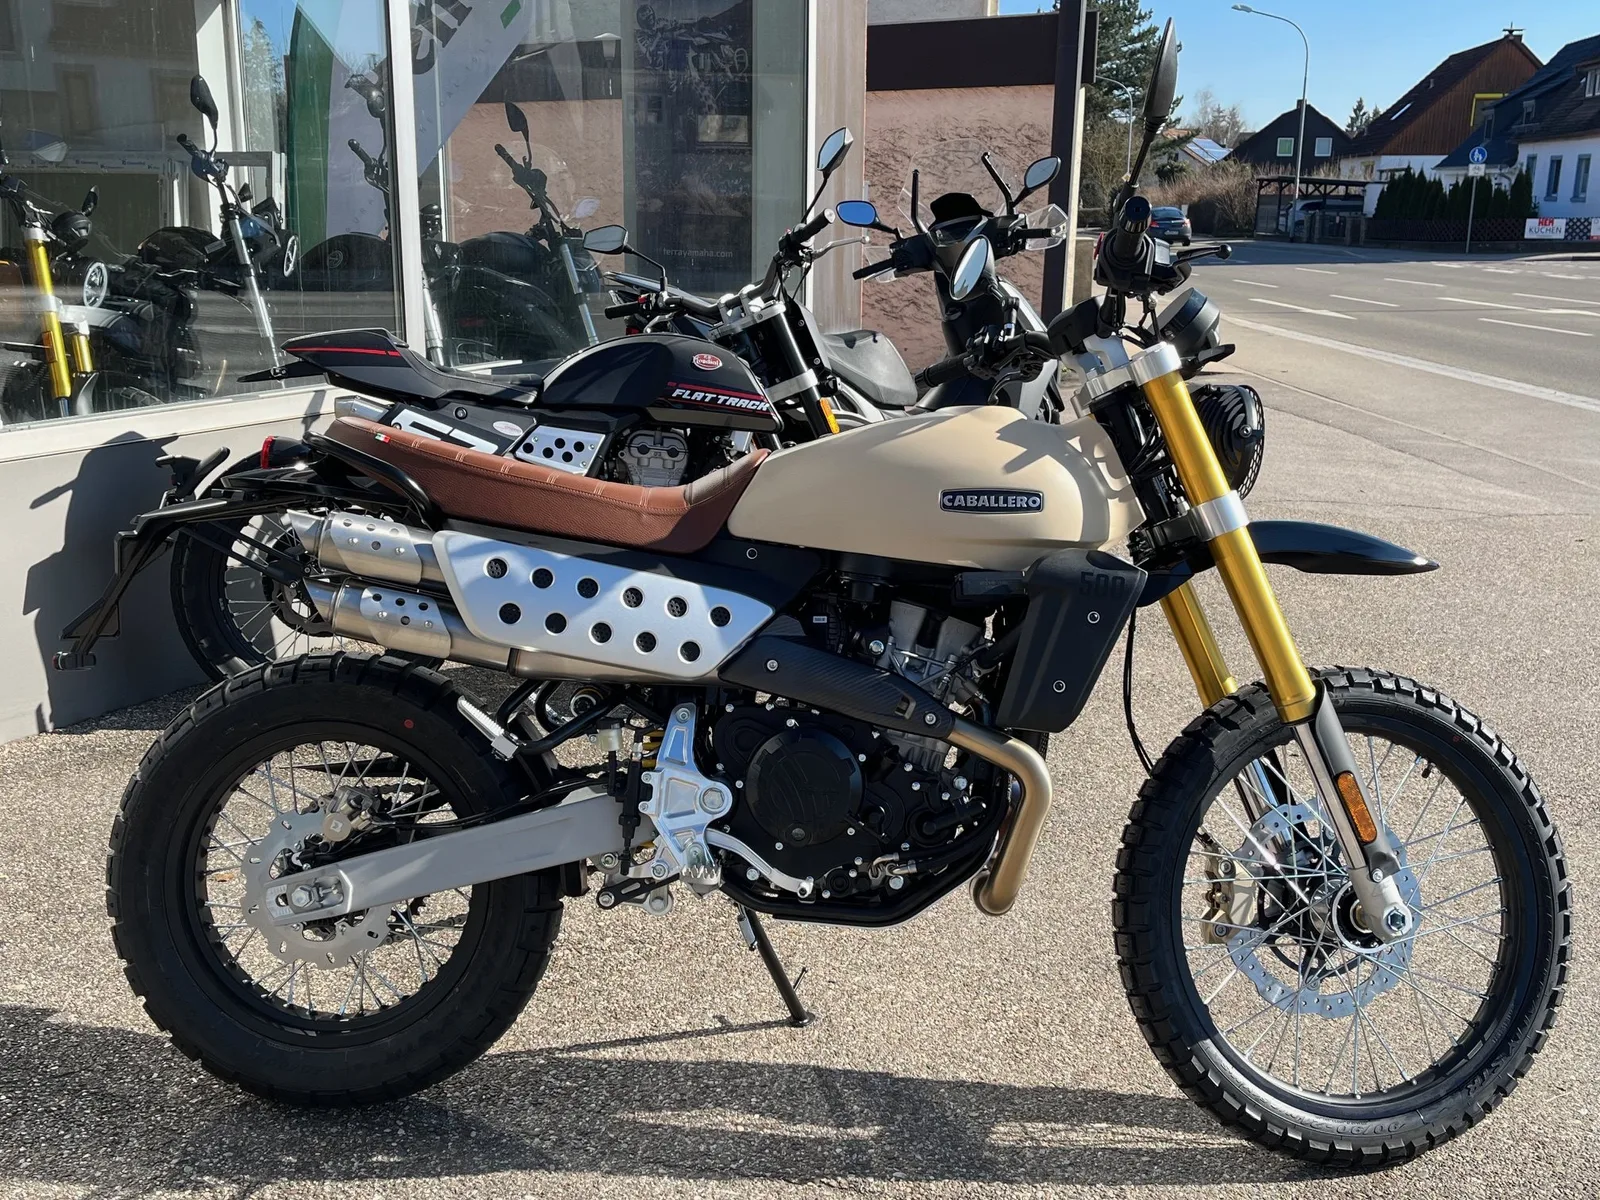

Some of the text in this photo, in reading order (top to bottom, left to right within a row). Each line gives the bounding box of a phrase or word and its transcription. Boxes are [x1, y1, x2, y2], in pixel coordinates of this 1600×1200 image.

[662, 247, 733, 258] terrayamaha.com
[672, 388, 771, 412] FLAT TRACK
[943, 495, 1041, 508] CABALLERO
[1080, 571, 1126, 599] 500
